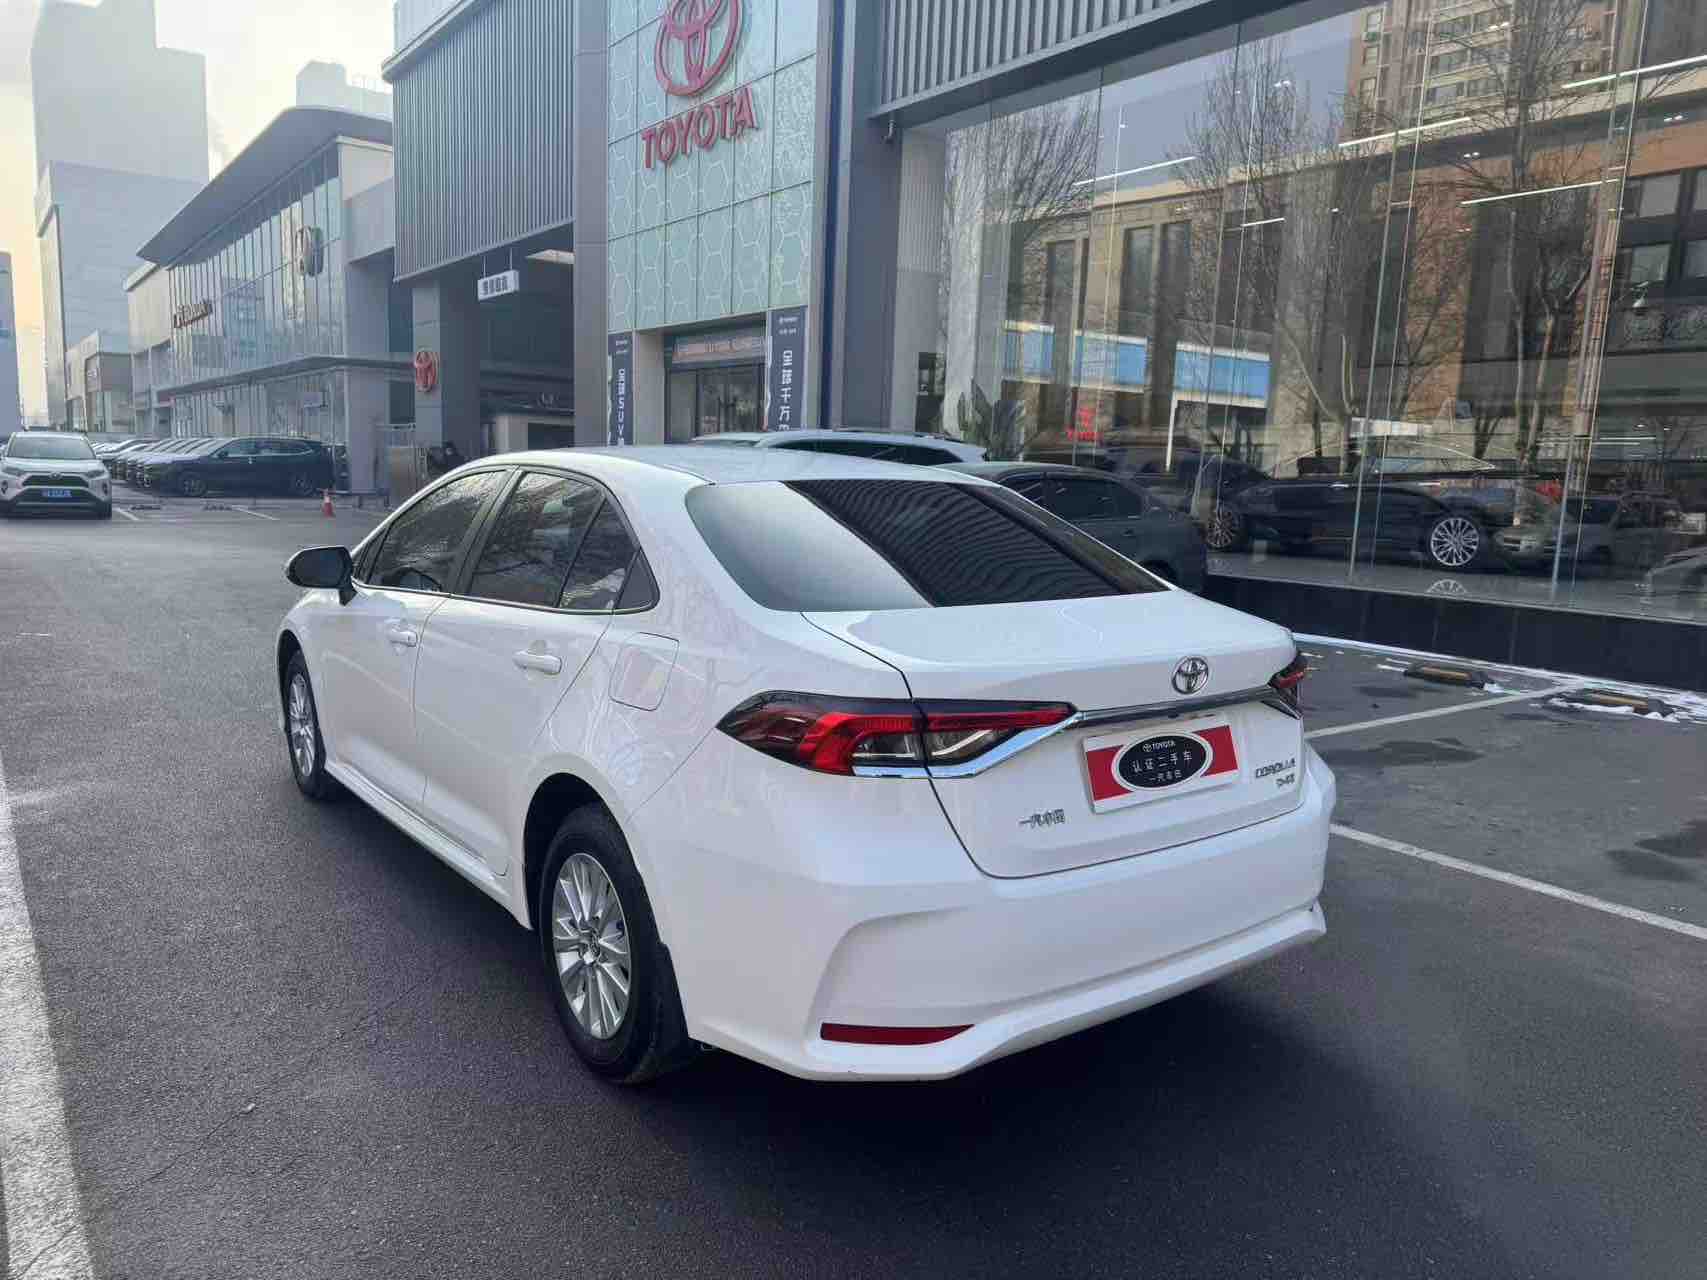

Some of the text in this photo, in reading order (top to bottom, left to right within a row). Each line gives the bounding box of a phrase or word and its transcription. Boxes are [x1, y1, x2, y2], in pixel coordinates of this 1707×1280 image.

[641, 85, 757, 169] TOYOTA
[1131, 750, 1193, 774] 认证二手车
[1255, 757, 1296, 778] COROLLA
